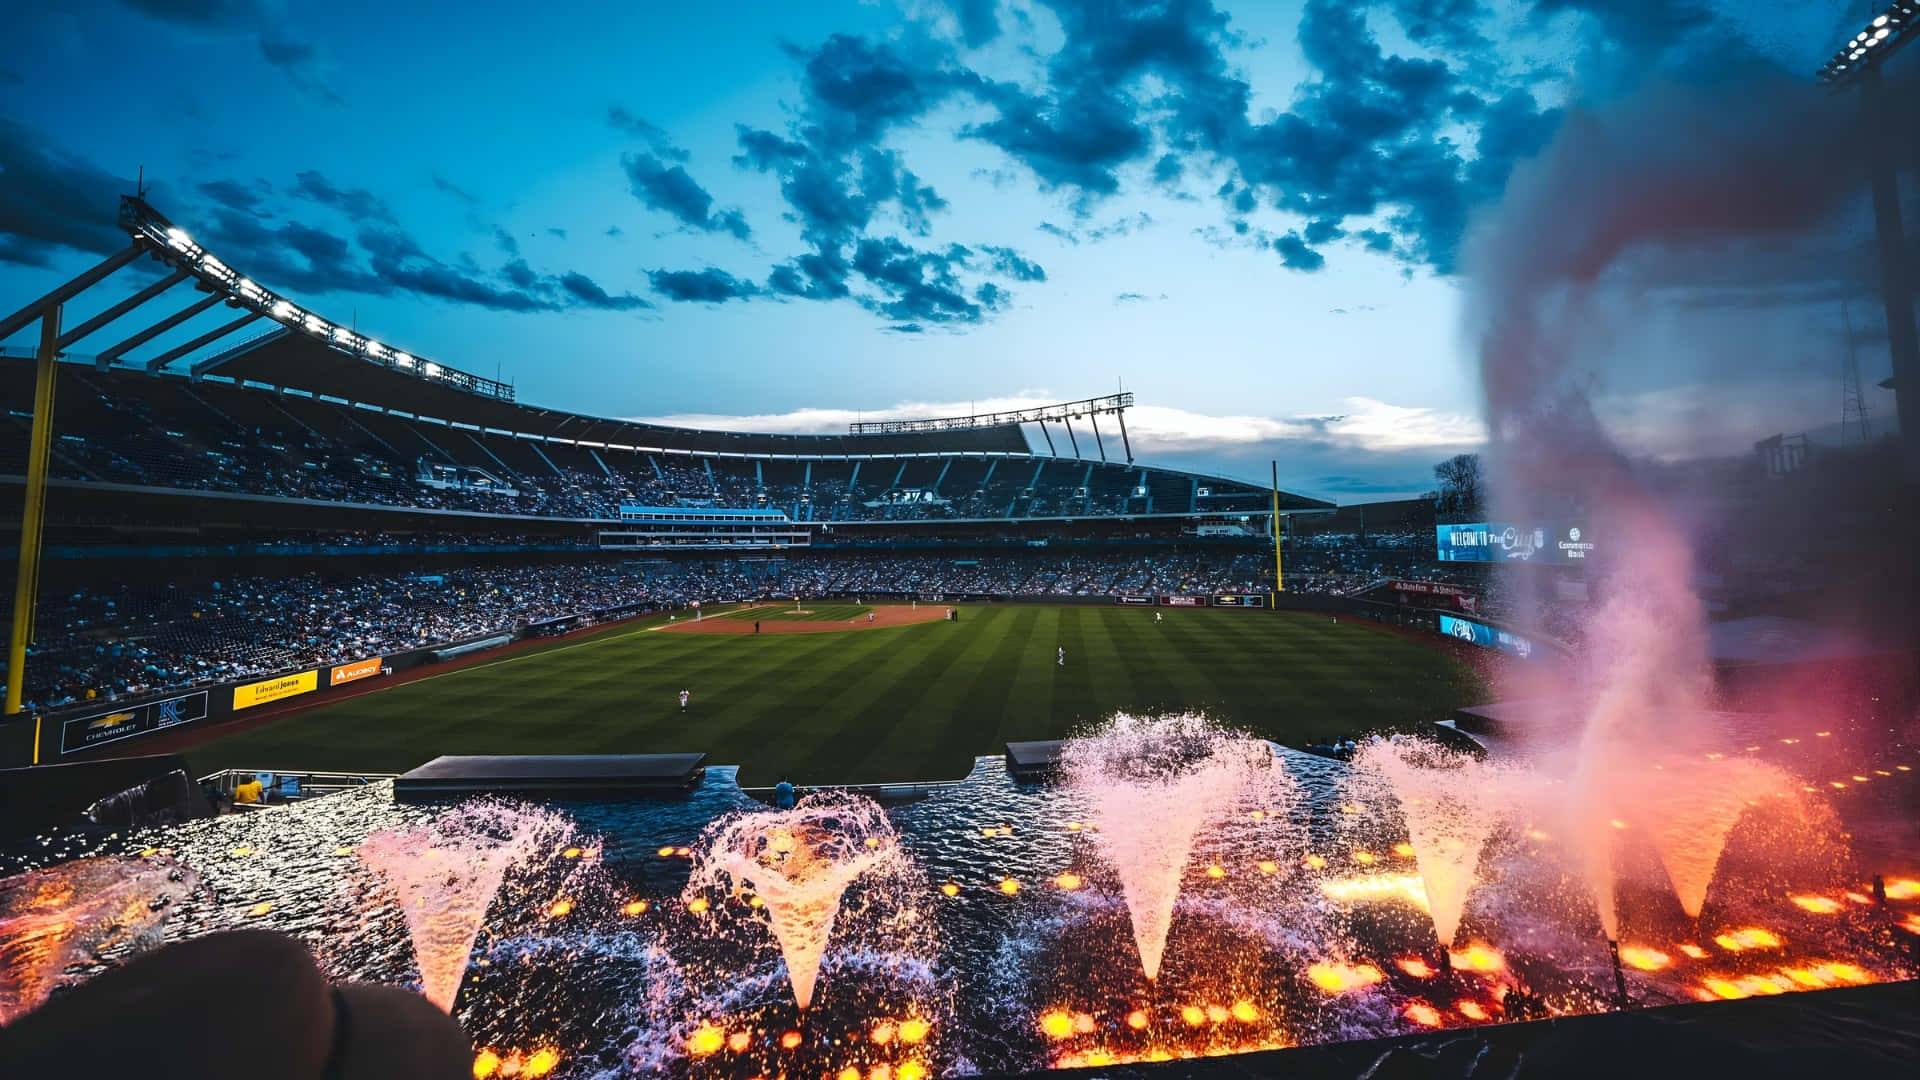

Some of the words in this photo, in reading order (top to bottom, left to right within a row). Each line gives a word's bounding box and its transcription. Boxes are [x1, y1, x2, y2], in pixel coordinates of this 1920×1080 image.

[1450, 531, 1478, 547] WELCOME
[1480, 531, 1488, 546] TO
[159, 698, 187, 723] KC
[86, 723, 137, 742] CHEVROLET
